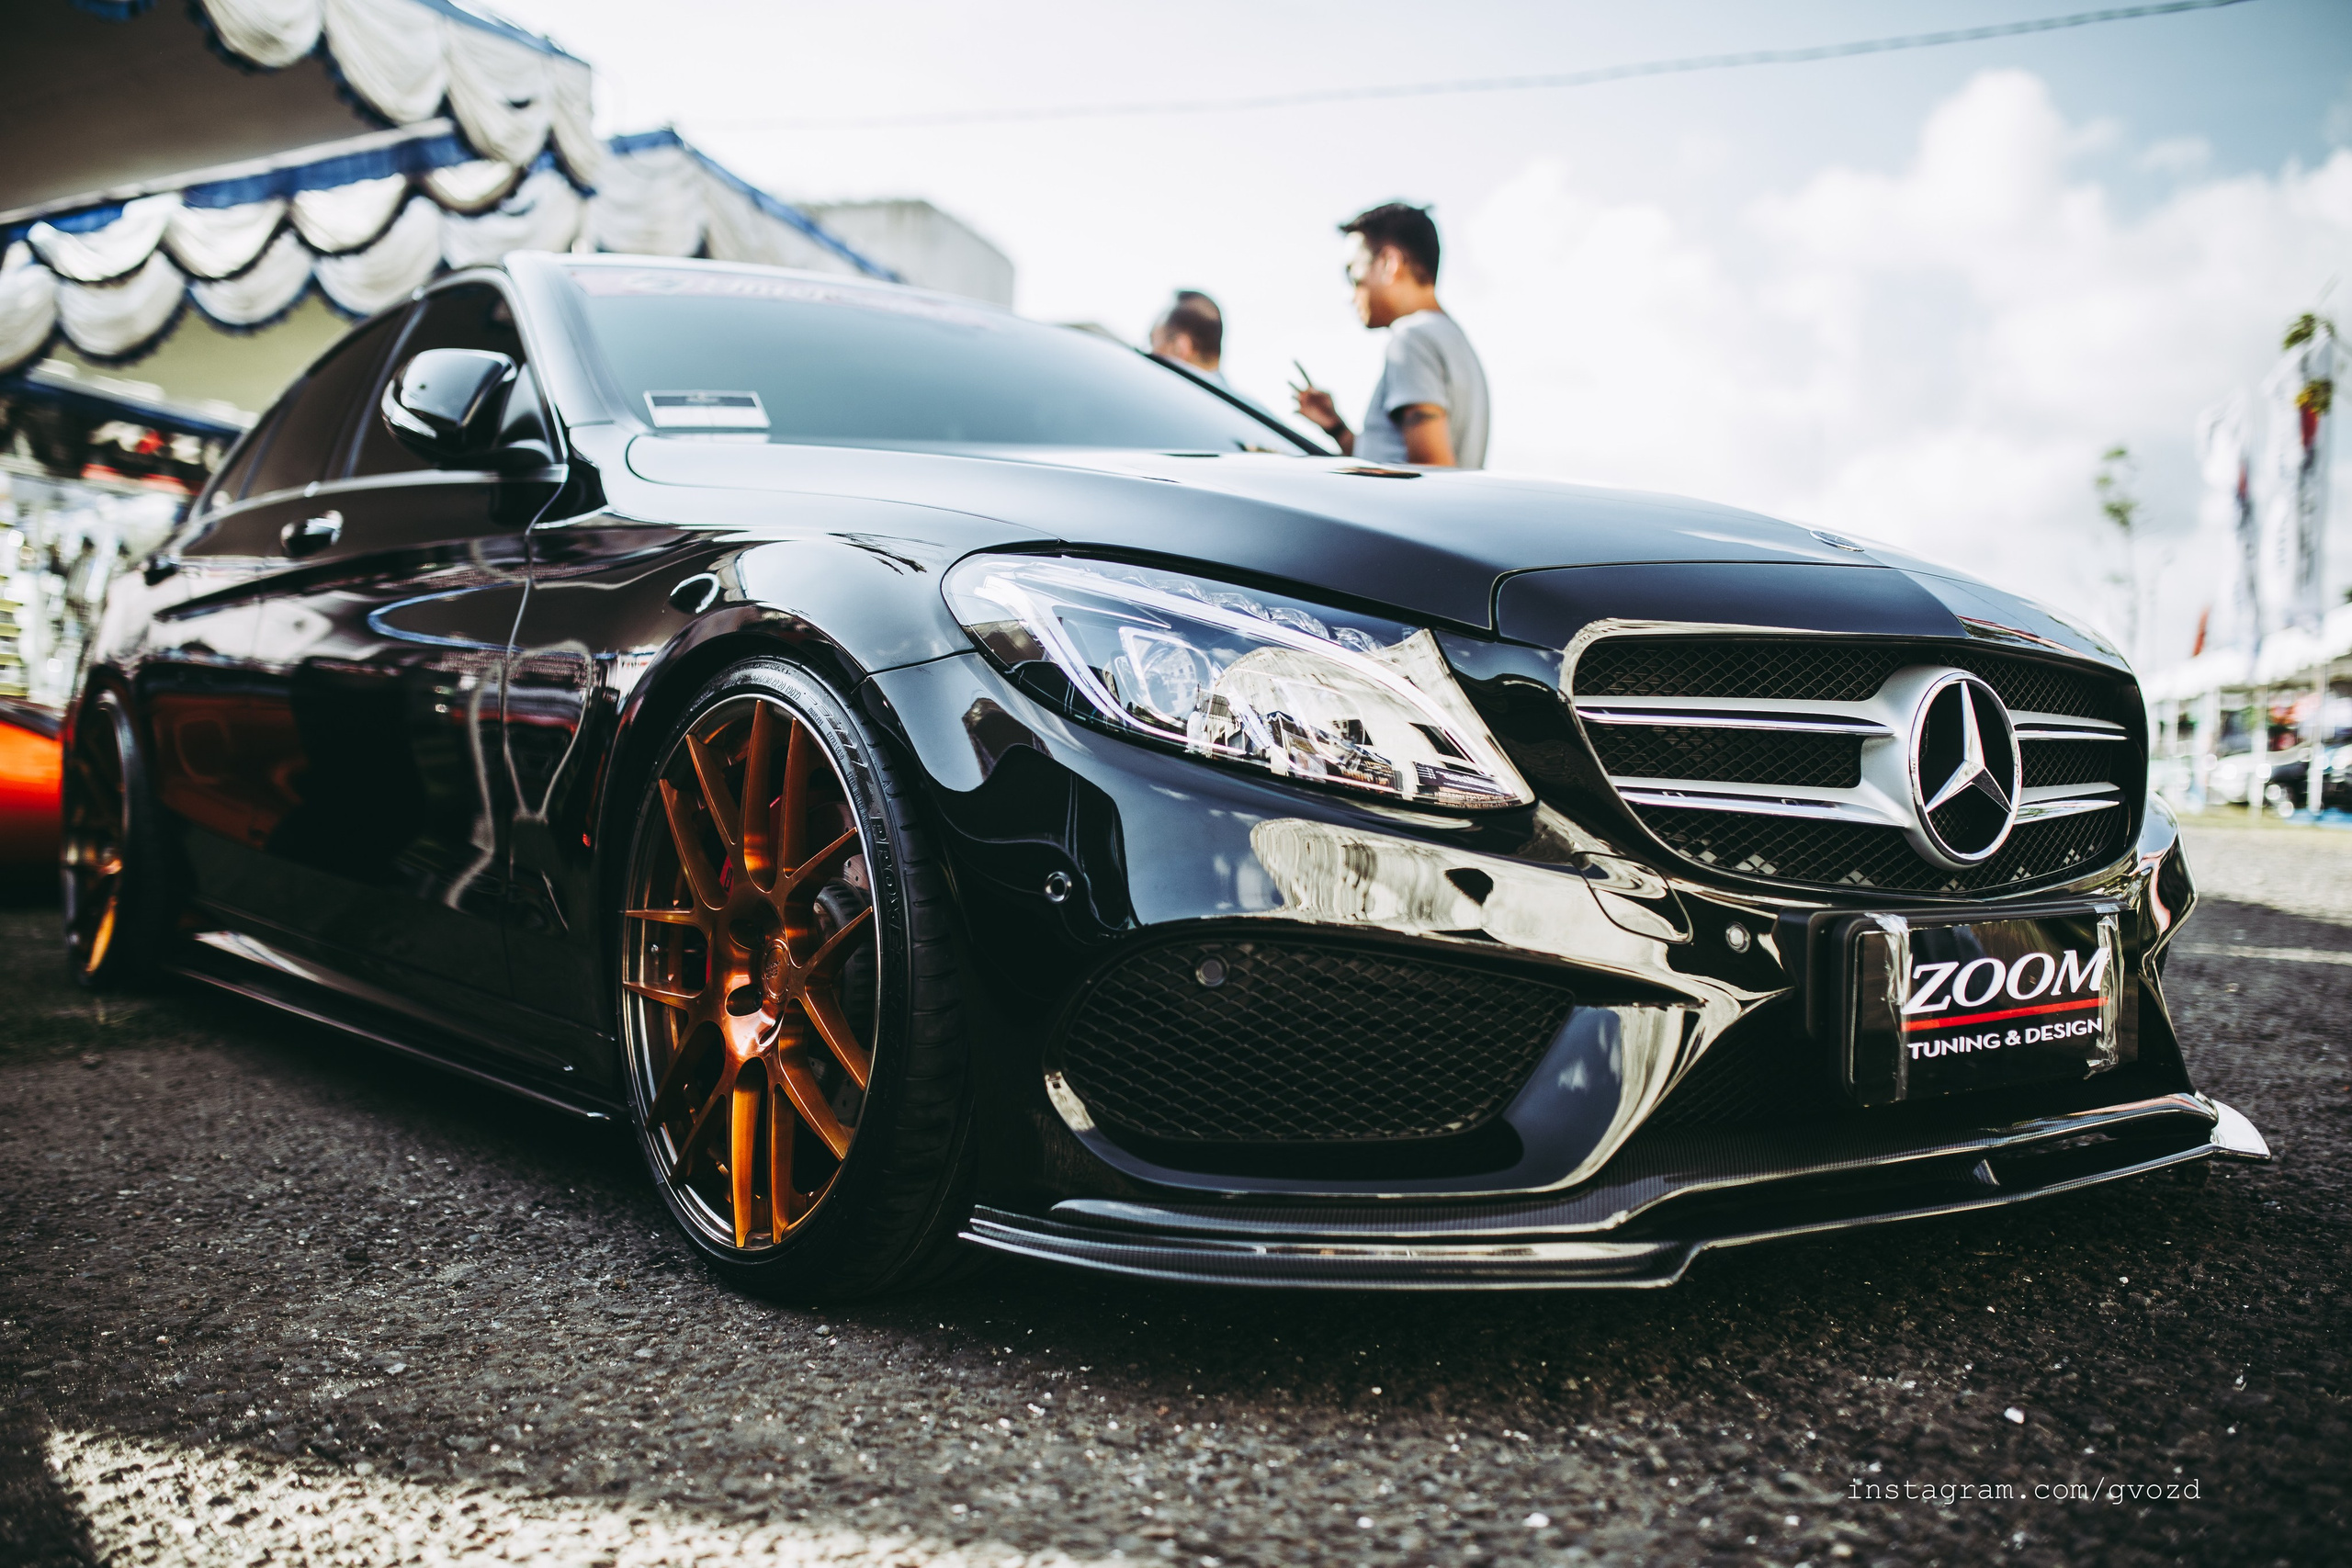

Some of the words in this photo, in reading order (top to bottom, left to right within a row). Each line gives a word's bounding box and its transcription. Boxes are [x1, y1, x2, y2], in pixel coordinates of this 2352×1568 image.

[1901, 947, 2110, 1015] ZOOM
[1907, 1032, 2002, 1060] TUNING
[2004, 1030, 2022, 1047] &
[2024, 1017, 2103, 1044] DESIGN
